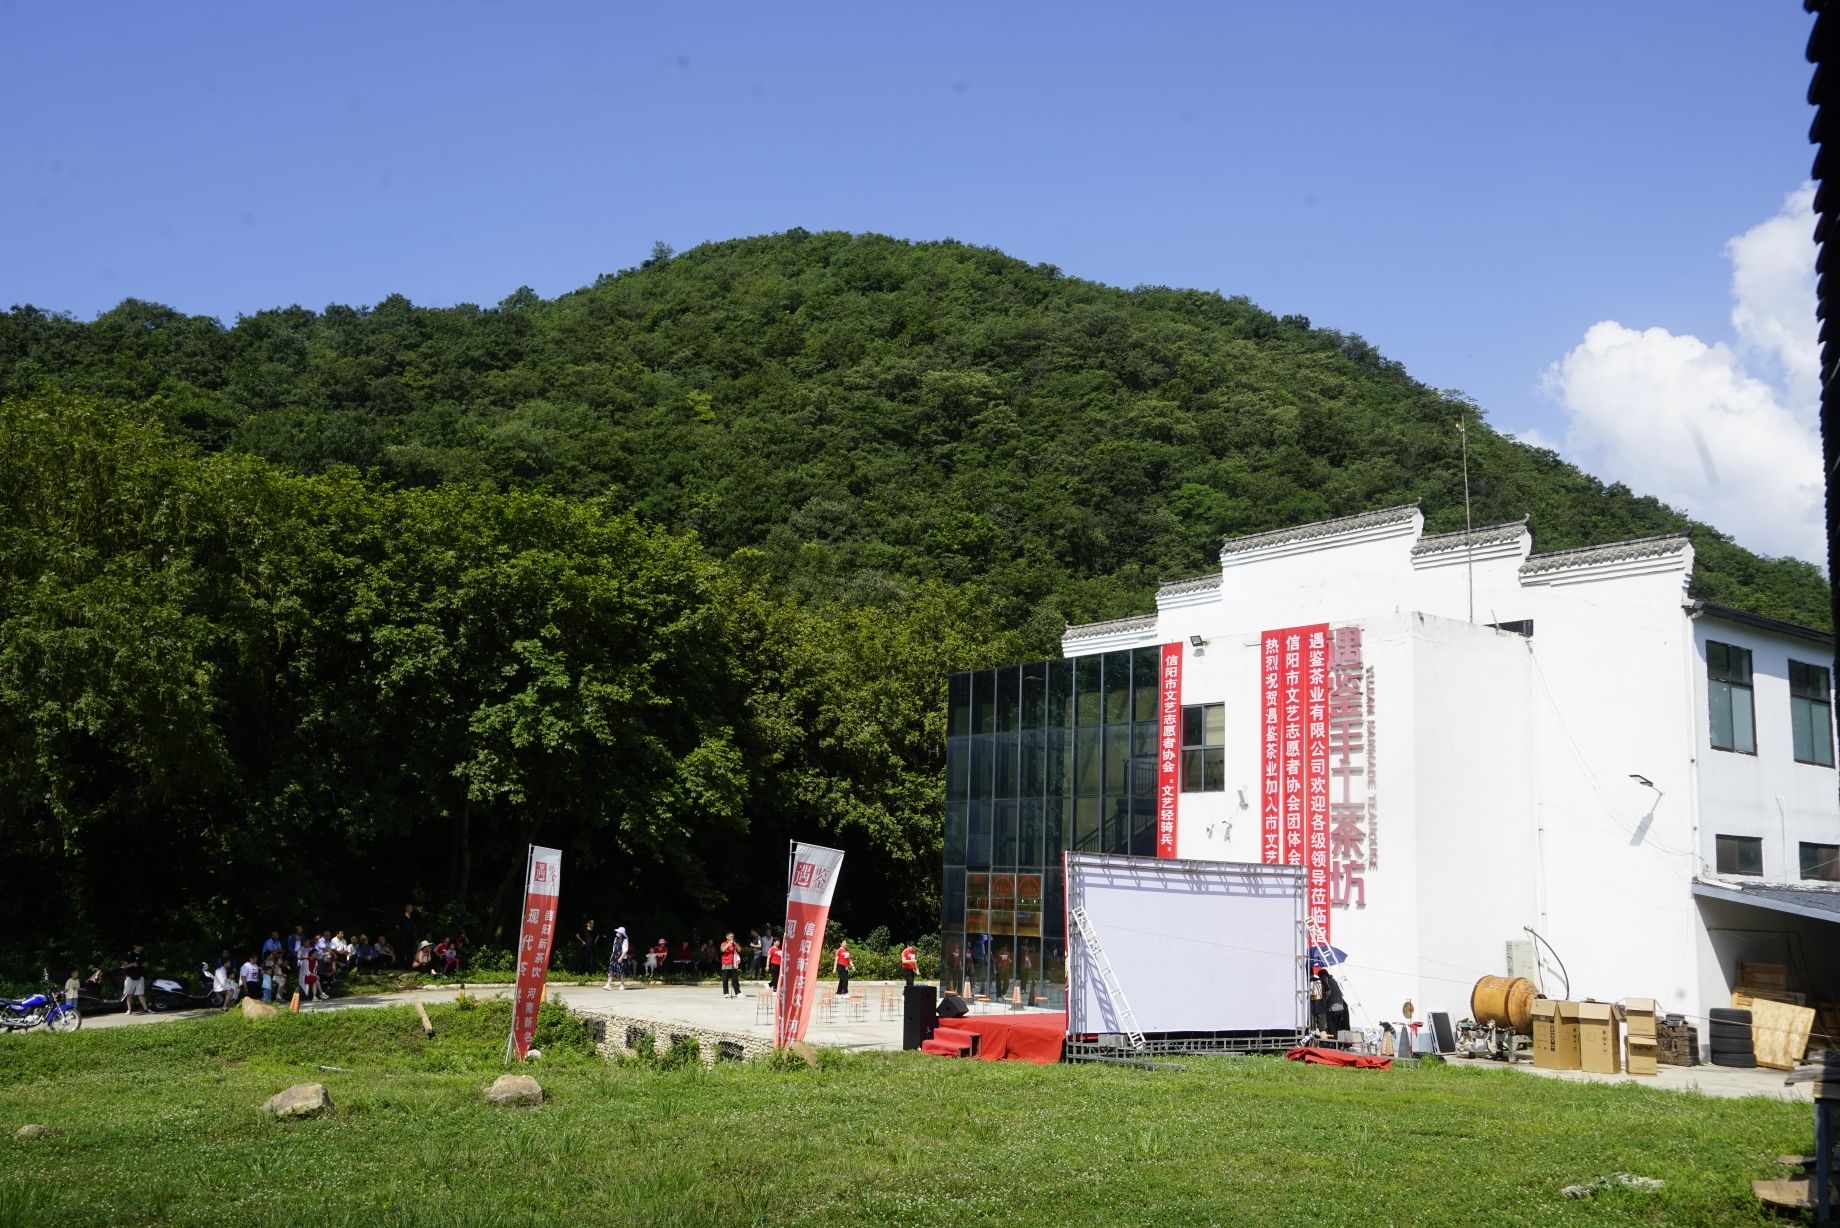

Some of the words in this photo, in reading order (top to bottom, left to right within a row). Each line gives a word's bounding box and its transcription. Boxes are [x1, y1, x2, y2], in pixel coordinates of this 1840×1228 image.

[1286, 635, 1301, 865] 信阳市文艺志愿者协会团体会
